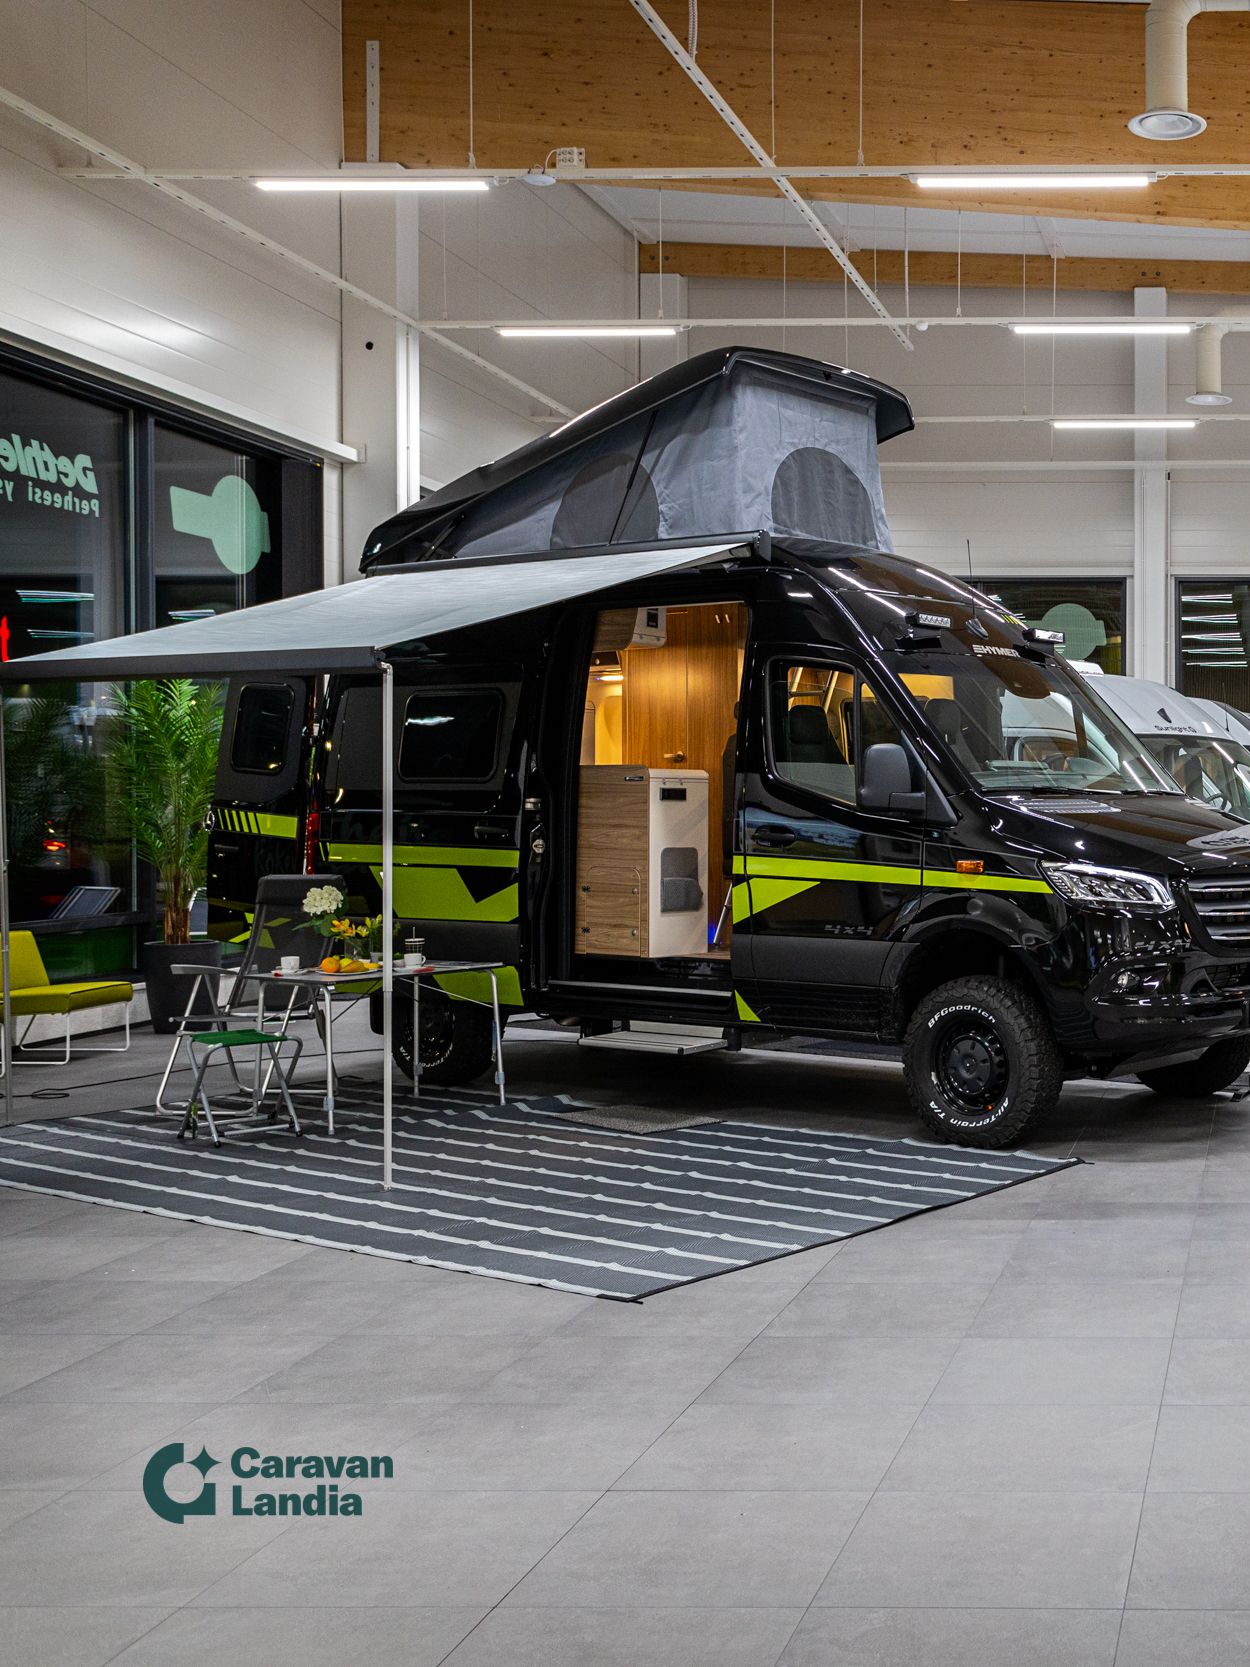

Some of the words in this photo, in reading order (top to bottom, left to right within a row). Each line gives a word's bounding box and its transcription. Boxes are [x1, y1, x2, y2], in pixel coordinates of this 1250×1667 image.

[981, 645, 1020, 658] HYMER
[927, 1004, 996, 1028] BFGoodrich
[929, 1100, 946, 1119] T/A
[949, 1097, 1009, 1127] All-Terrain
